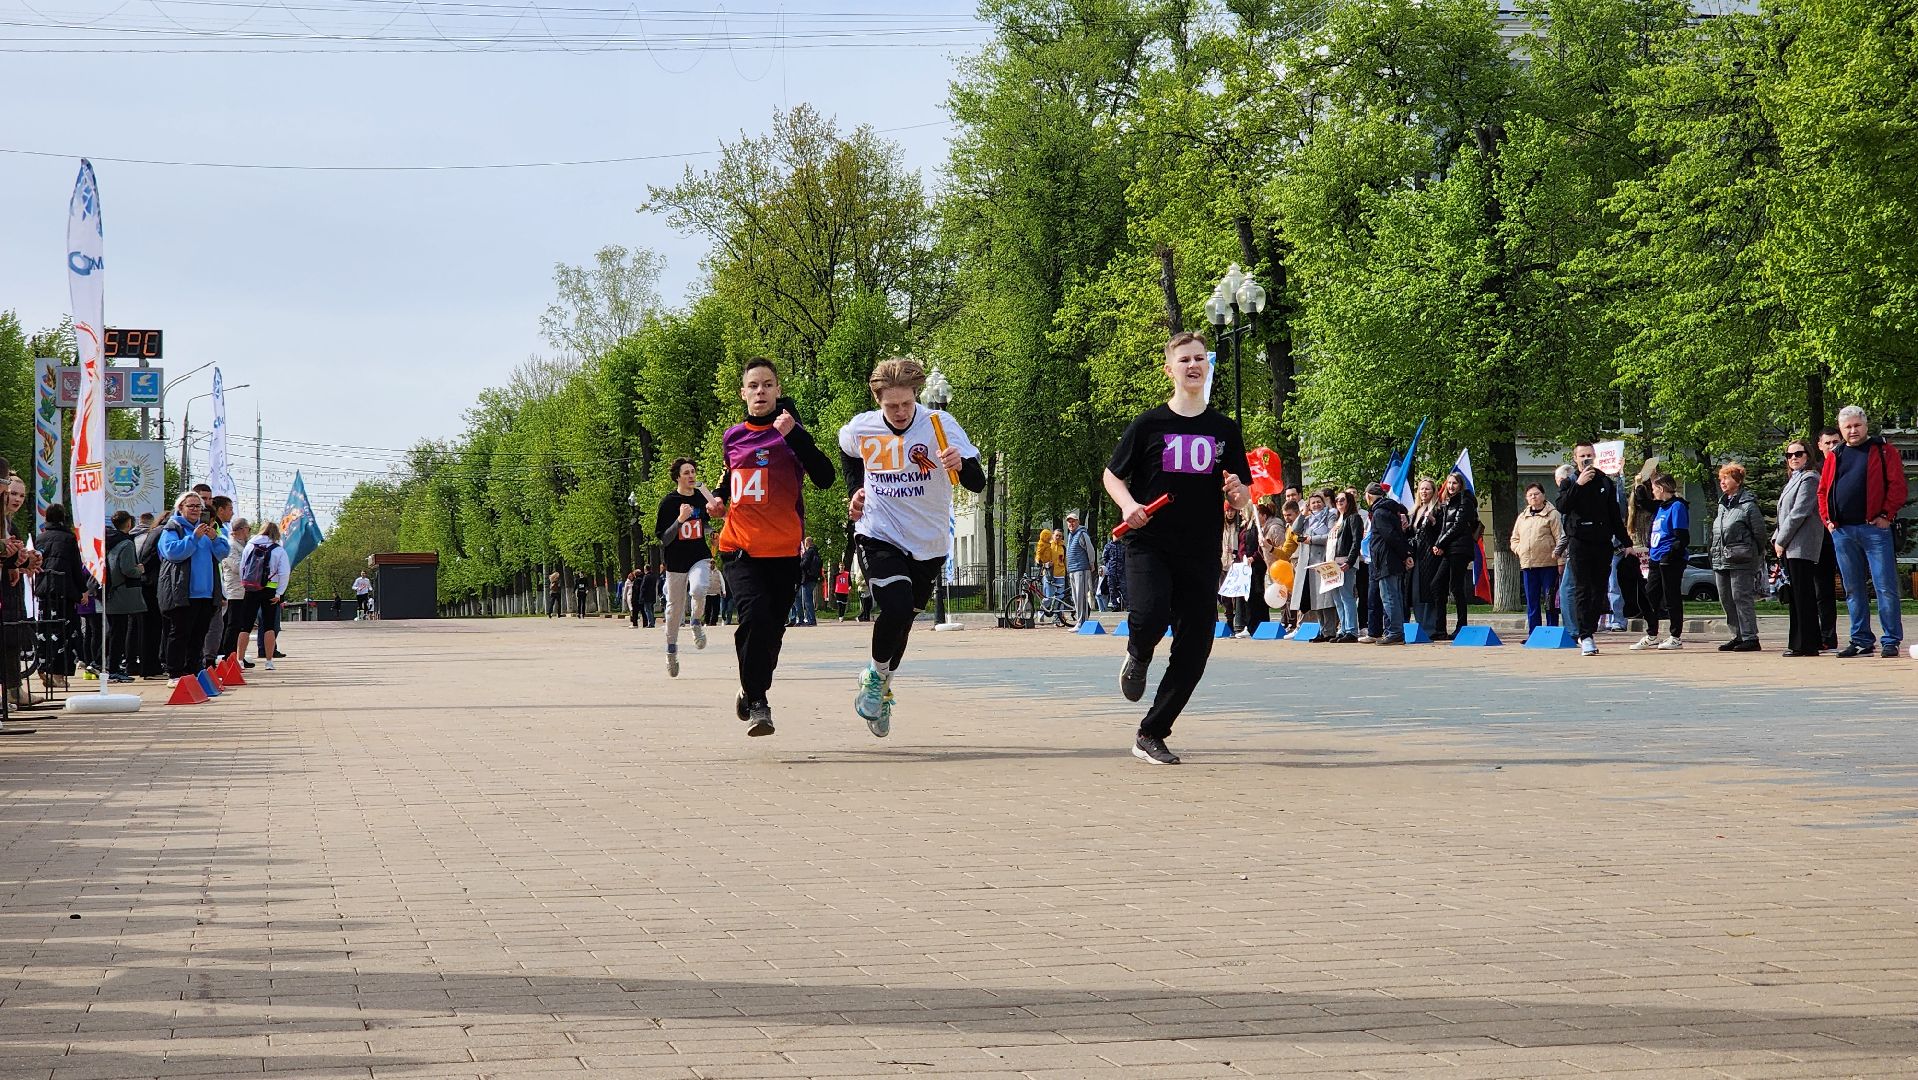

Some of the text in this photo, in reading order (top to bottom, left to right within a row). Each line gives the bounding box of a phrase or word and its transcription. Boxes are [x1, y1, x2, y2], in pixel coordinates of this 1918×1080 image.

[863, 437, 900, 469] 21
[1167, 435, 1212, 471] 10
[731, 469, 765, 504] 04
[681, 520, 702, 539] 01
